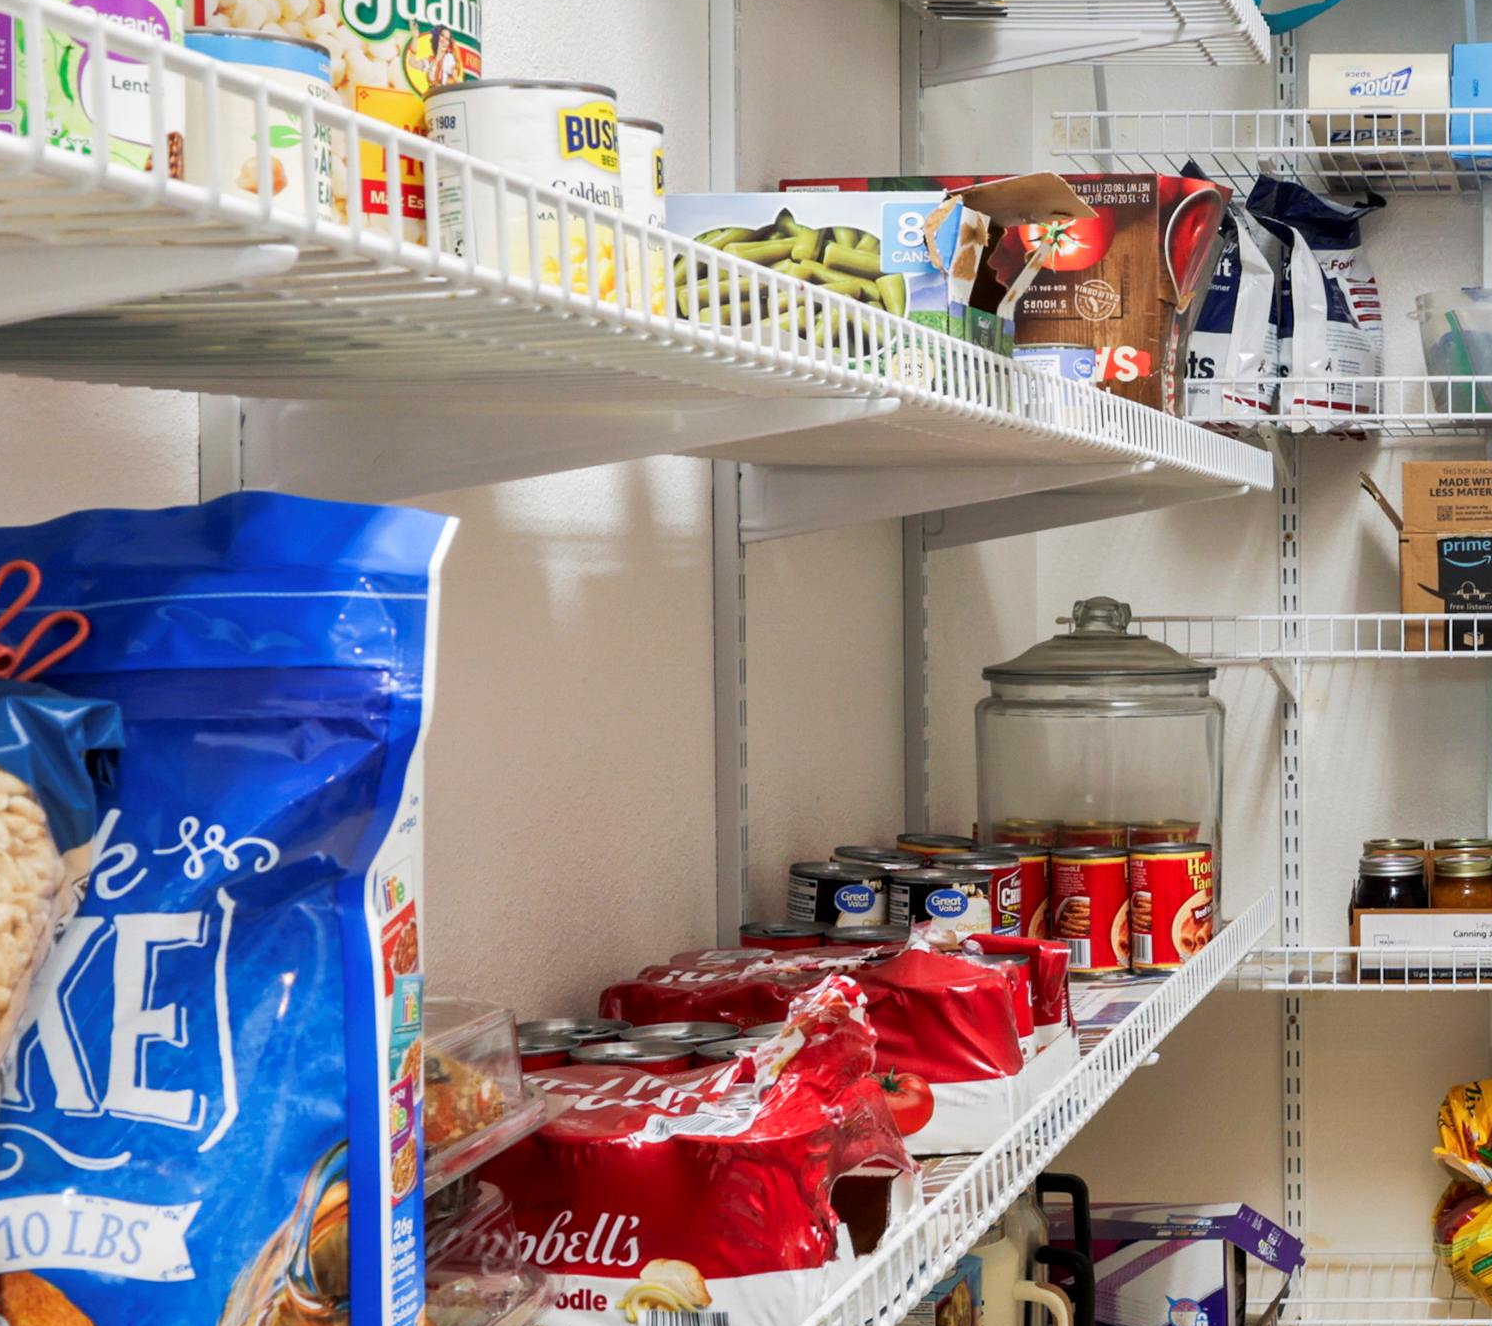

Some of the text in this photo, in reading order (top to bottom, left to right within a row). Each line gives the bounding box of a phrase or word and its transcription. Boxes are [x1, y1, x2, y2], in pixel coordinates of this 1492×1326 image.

[1350, 66, 1413, 97] Ziploc
[896, 209, 927, 247] 8
[1023, 299, 1058, 309] HOURS
[1438, 477, 1470, 487] MADE
[1429, 488, 1455, 497] LESS
[1443, 539, 1492, 555] prime
[840, 891, 870, 902] Great
[931, 896, 962, 907] Great
[847, 900, 869, 908] Value
[939, 905, 962, 913] Value
[1452, 929, 1487, 940] Canning
[0, 1213, 152, 1267] 10 LBS
